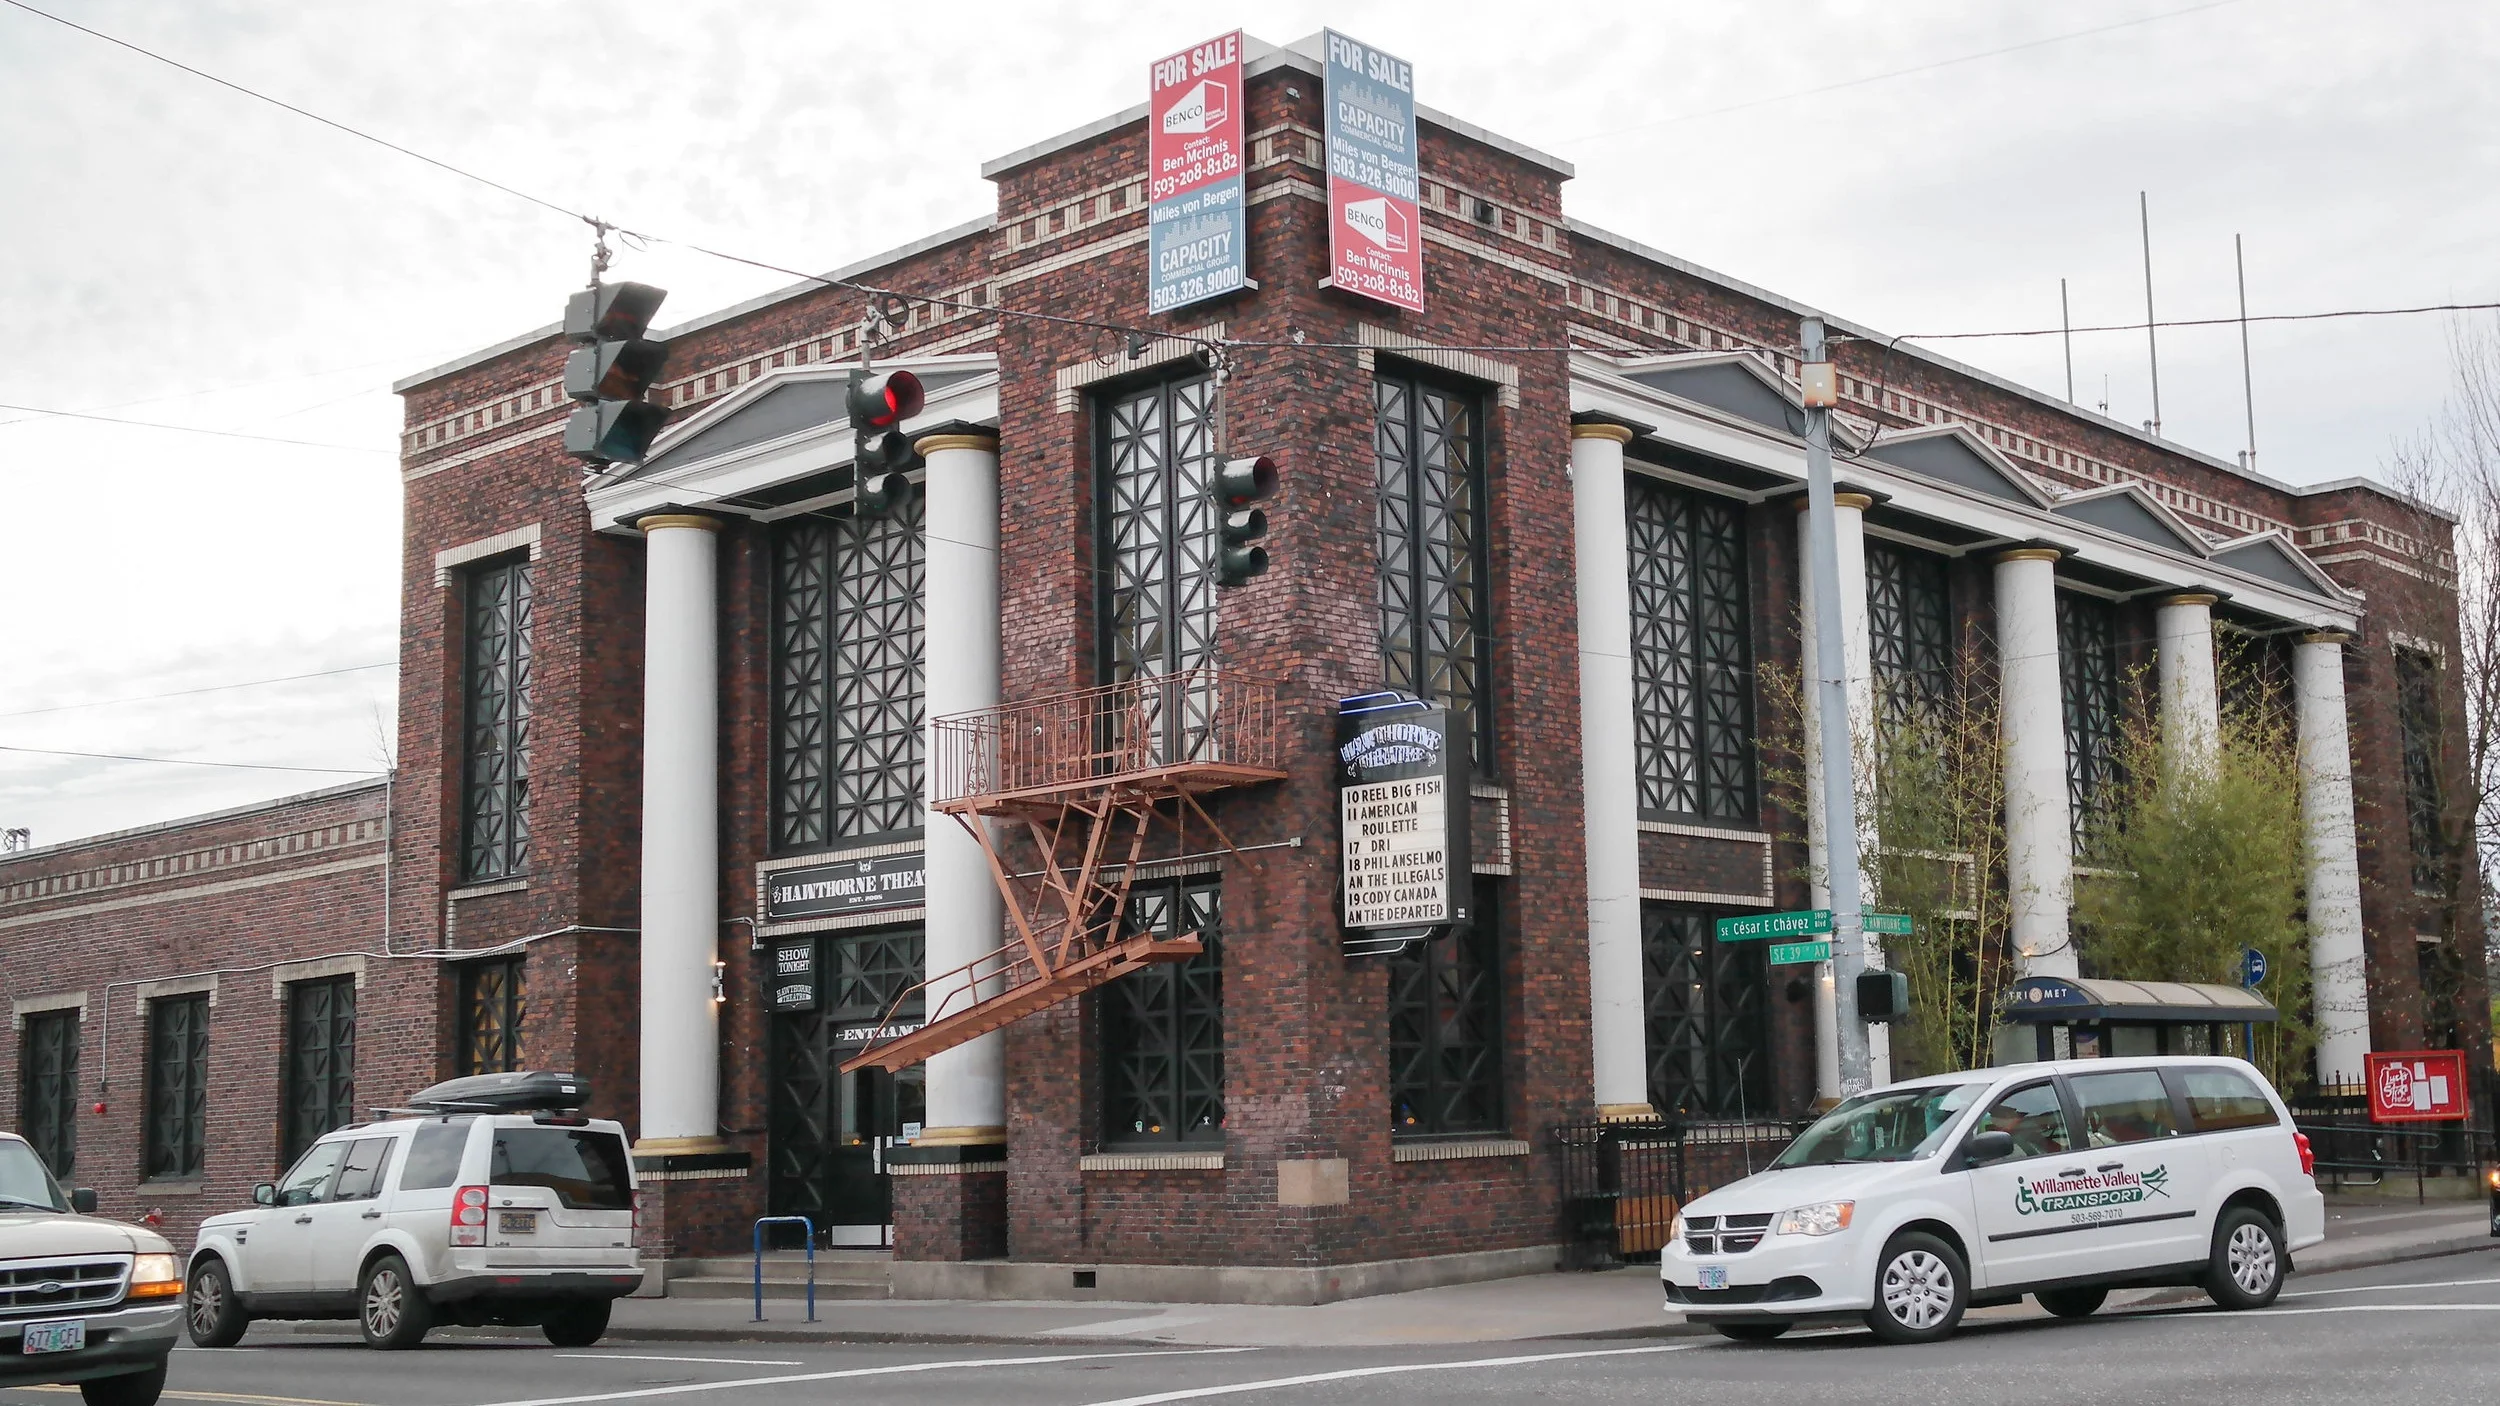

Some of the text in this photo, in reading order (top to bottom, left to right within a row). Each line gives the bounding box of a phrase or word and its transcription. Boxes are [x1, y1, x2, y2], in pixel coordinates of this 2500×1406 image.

[1154, 36, 1236, 92] FOR SALE
[1329, 34, 1410, 94] FOR SALE
[1166, 105, 1203, 128] BENCO
[1338, 101, 1405, 145] CAPACITY
[1184, 136, 1211, 151] Contact:
[1340, 123, 1405, 154] COMMERCIAL GROUP
[1163, 138, 1229, 172] Ben McInnis
[1332, 135, 1415, 178] Miles von Bergen
[1154, 152, 1238, 200] 503-208-8182
[1333, 154, 1415, 200] 503.326.9000
[1153, 186, 1238, 225] Miles von Bergen
[1347, 208, 1384, 230] BENCO
[1160, 231, 1232, 273] CAPACITY
[1366, 246, 1392, 262] Contact:
[1161, 255, 1231, 283] COMMERCIAL GROUP
[1346, 248, 1410, 281] Ben McInnis
[1154, 265, 1238, 309] 503.326.9000
[1338, 265, 1420, 303] 503-208-8182
[1347, 780, 1440, 804] 10 REEL BIG FISH
[1348, 800, 1417, 821] 11 AMERICAN
[1362, 818, 1418, 836] ROULETTE
[1349, 839, 1390, 855] 17 DRI
[1349, 850, 1442, 872] 18 PHIL ANSELMO
[781, 875, 877, 903] HAWTHORNE
[1349, 867, 1444, 889] AN THE ILLEGALS
[1349, 886, 1437, 906] 19 CODY CANADA
[1348, 910, 1362, 924] AN
[1364, 908, 1384, 922] THE
[1387, 903, 1443, 920] DEPARTED
[1721, 917, 1809, 936] SE César E Chávez
[778, 947, 810, 961] SHOW
[1774, 947, 1785, 961] SE
[1815, 944, 1826, 957] AV
[778, 960, 810, 973] TONIGHT
[2044, 988, 2067, 999] MET
[843, 1024, 926, 1041] ENTRANC
[2031, 1171, 2140, 1195] Willamette Valley
[2044, 1189, 2141, 1211] TRANSPORT
[27, 1327, 81, 1347] 677 CFL
